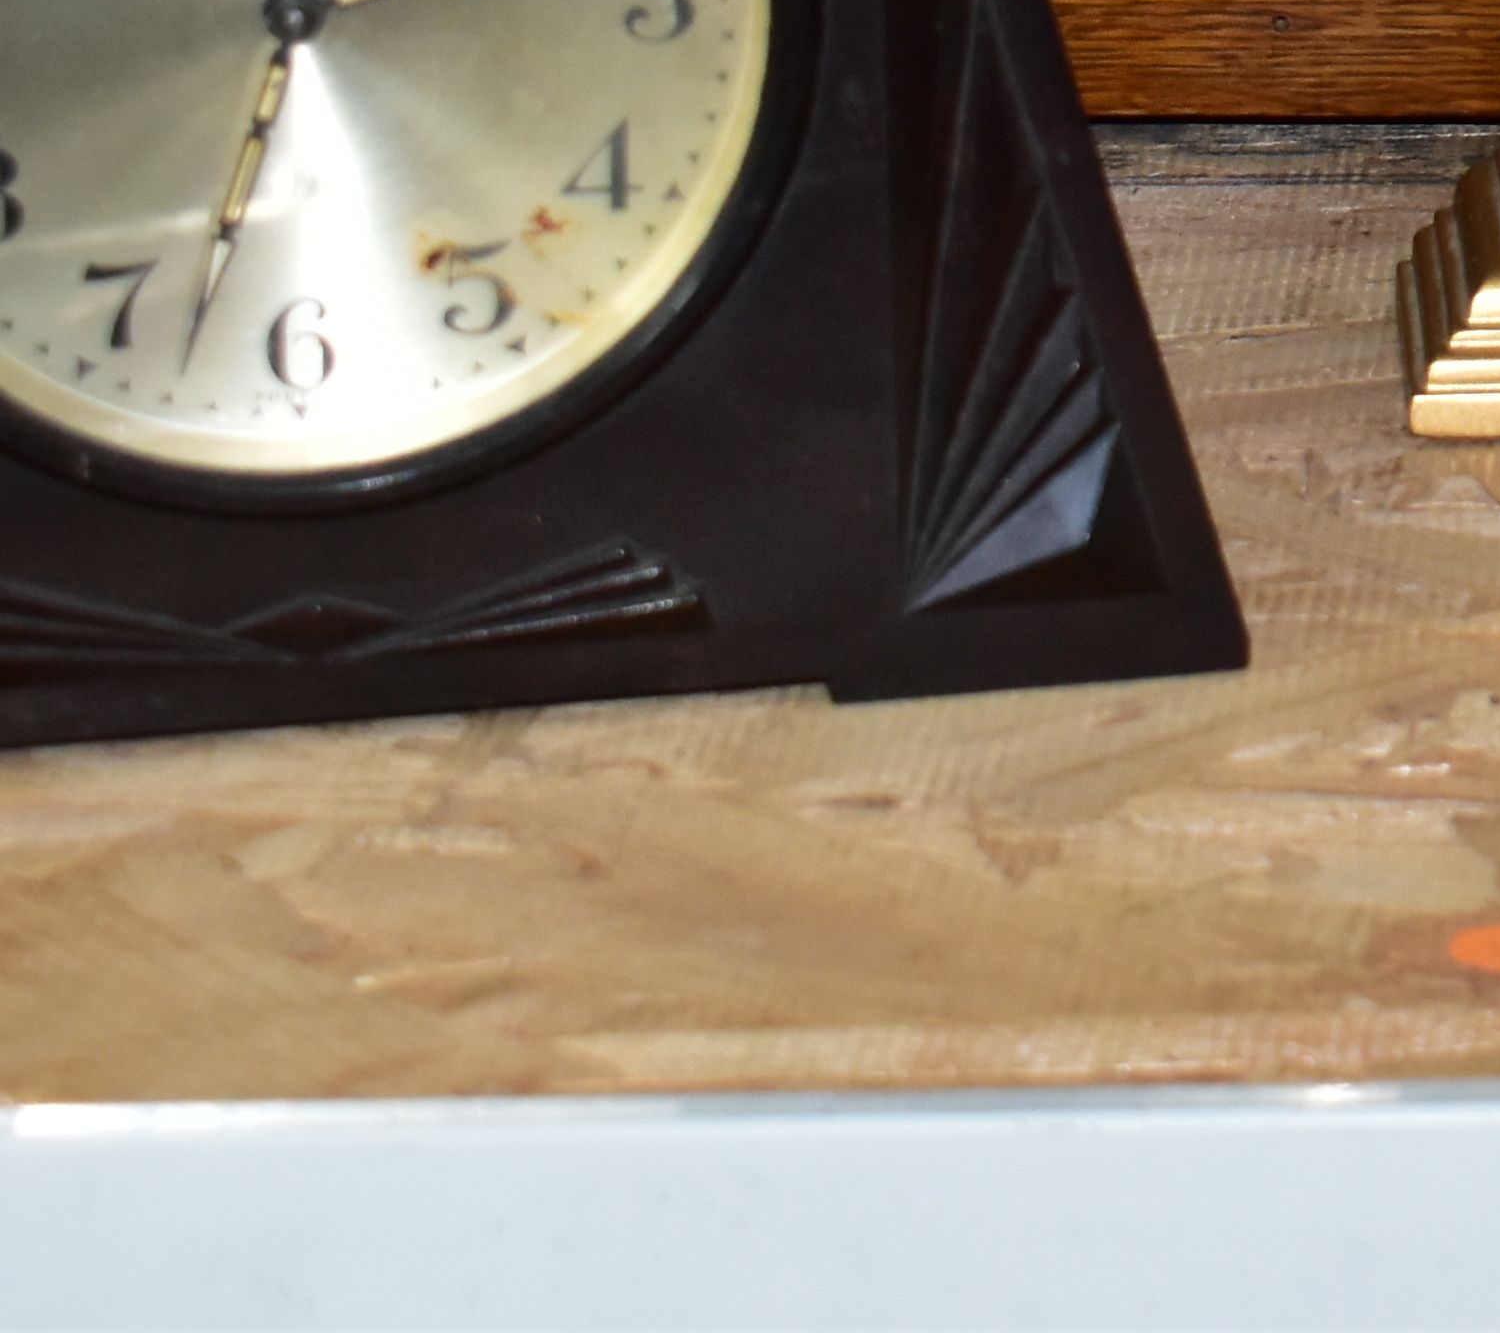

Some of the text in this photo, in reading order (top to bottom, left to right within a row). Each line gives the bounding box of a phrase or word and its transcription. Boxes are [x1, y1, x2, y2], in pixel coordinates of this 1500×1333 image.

[562, 117, 644, 211] 4
[83, 257, 160, 349] 7
[441, 241, 518, 334] 5
[266, 295, 337, 391] 6
